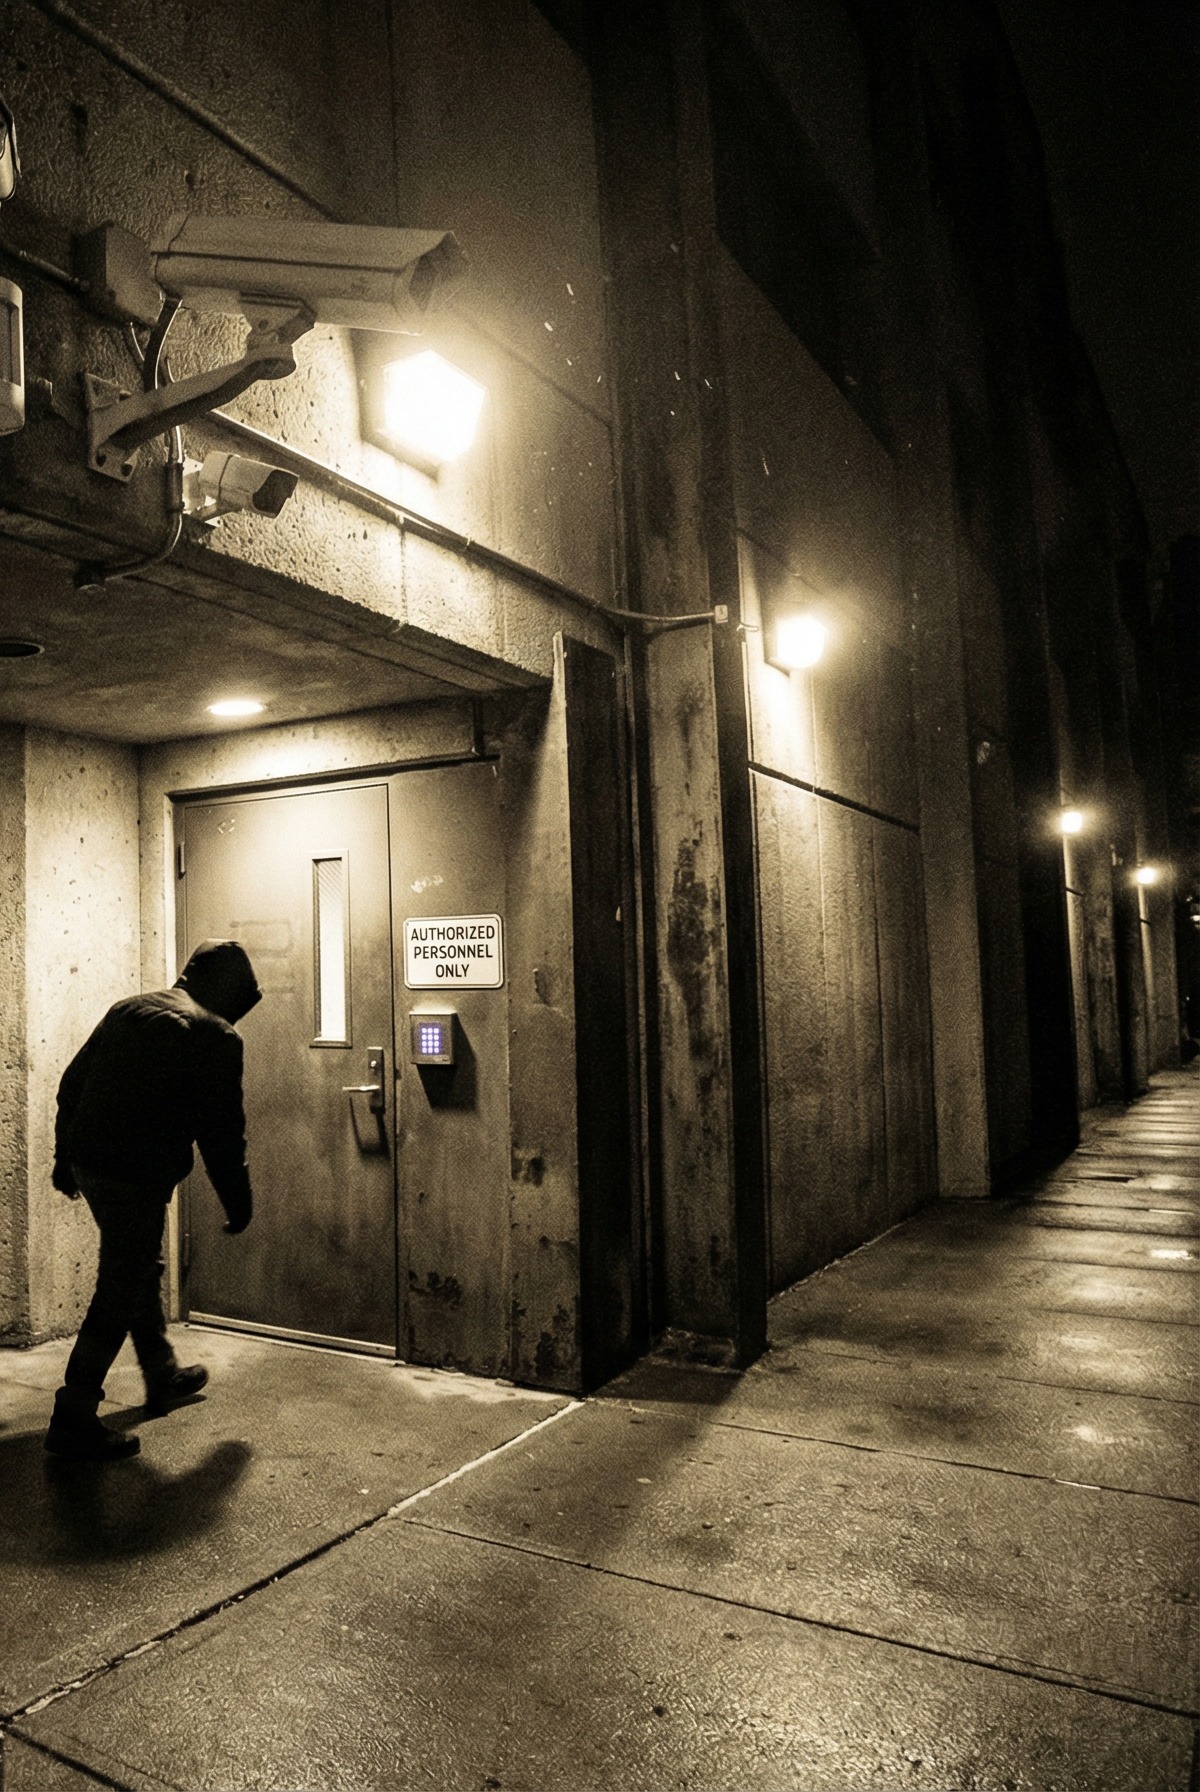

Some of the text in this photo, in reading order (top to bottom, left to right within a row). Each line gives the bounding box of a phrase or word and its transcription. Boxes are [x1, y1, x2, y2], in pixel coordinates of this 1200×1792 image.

[411, 926, 495, 941] AUTHORIZED
[414, 944, 493, 959] PERSONNEL
[435, 964, 470, 978] ONLY
